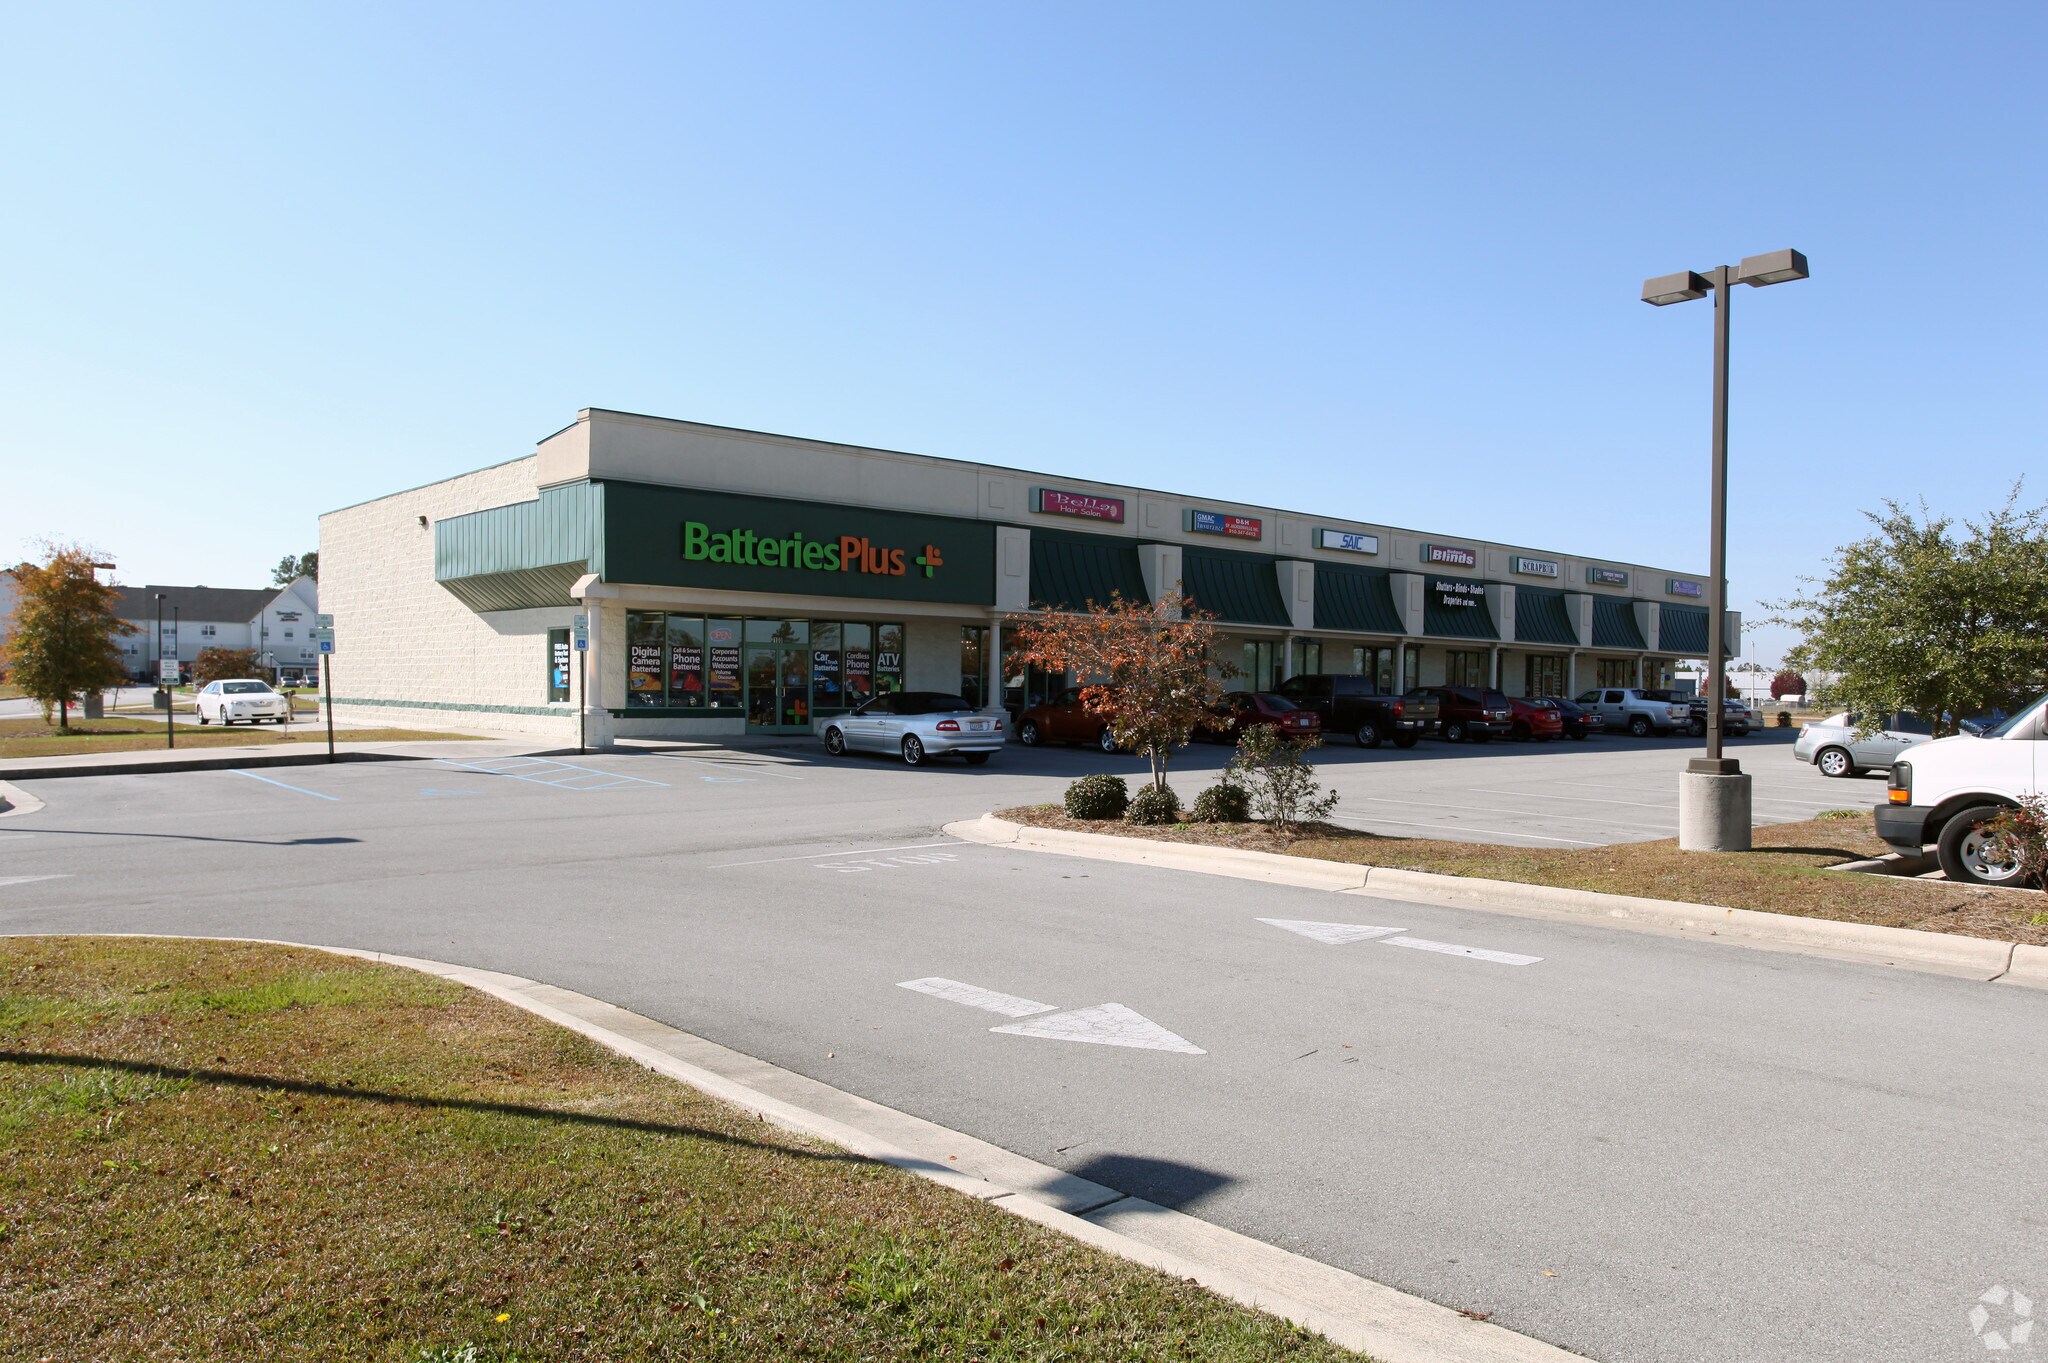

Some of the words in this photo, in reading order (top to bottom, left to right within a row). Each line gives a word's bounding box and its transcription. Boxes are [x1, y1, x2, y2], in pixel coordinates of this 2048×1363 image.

[1050, 493, 1110, 511] Bella
[1060, 505, 1078, 513] Hair
[1080, 508, 1101, 517] Salon
[1197, 513, 1215, 522] GMAC
[1340, 534, 1364, 550] SAIC
[1432, 549, 1474, 565] Blinds
[1455, 583, 1468, 593] Blinds
[1470, 584, 1484, 595] Shades
[711, 631, 732, 639] OPEN
[631, 646, 661, 659] Digital
[711, 648, 738, 656] Corporate
[814, 651, 829, 662] Car
[846, 652, 870, 660] Cordless
[631, 656, 660, 665] Camera
[672, 653, 700, 663] Phone
[877, 652, 900, 666] ATV
[631, 665, 660, 673] Batteries
[672, 663, 700, 671] Batteries
[814, 664, 839, 672] Batteries
[846, 659, 870, 669] Phone
[876, 665, 900, 673] Batteries
[846, 668, 870, 676] Batteries
[813, 852, 960, 873] STOP
